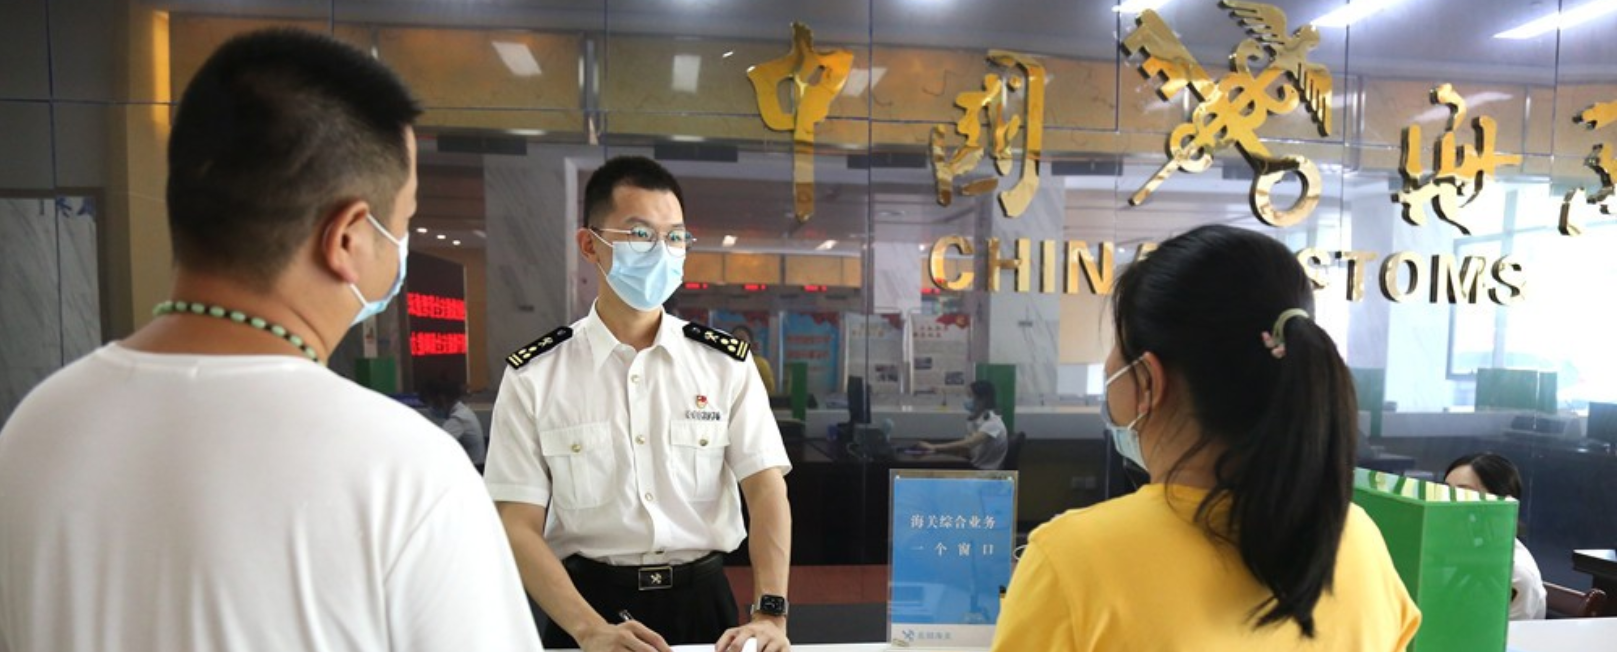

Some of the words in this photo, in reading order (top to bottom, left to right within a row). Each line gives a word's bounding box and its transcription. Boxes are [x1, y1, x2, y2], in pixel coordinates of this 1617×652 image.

[929, 236, 1158, 295] CHIN
[1297, 248, 1527, 305] STOMS
[910, 514, 996, 530] 海关综合业务
[910, 542, 995, 557] 一个窗口
